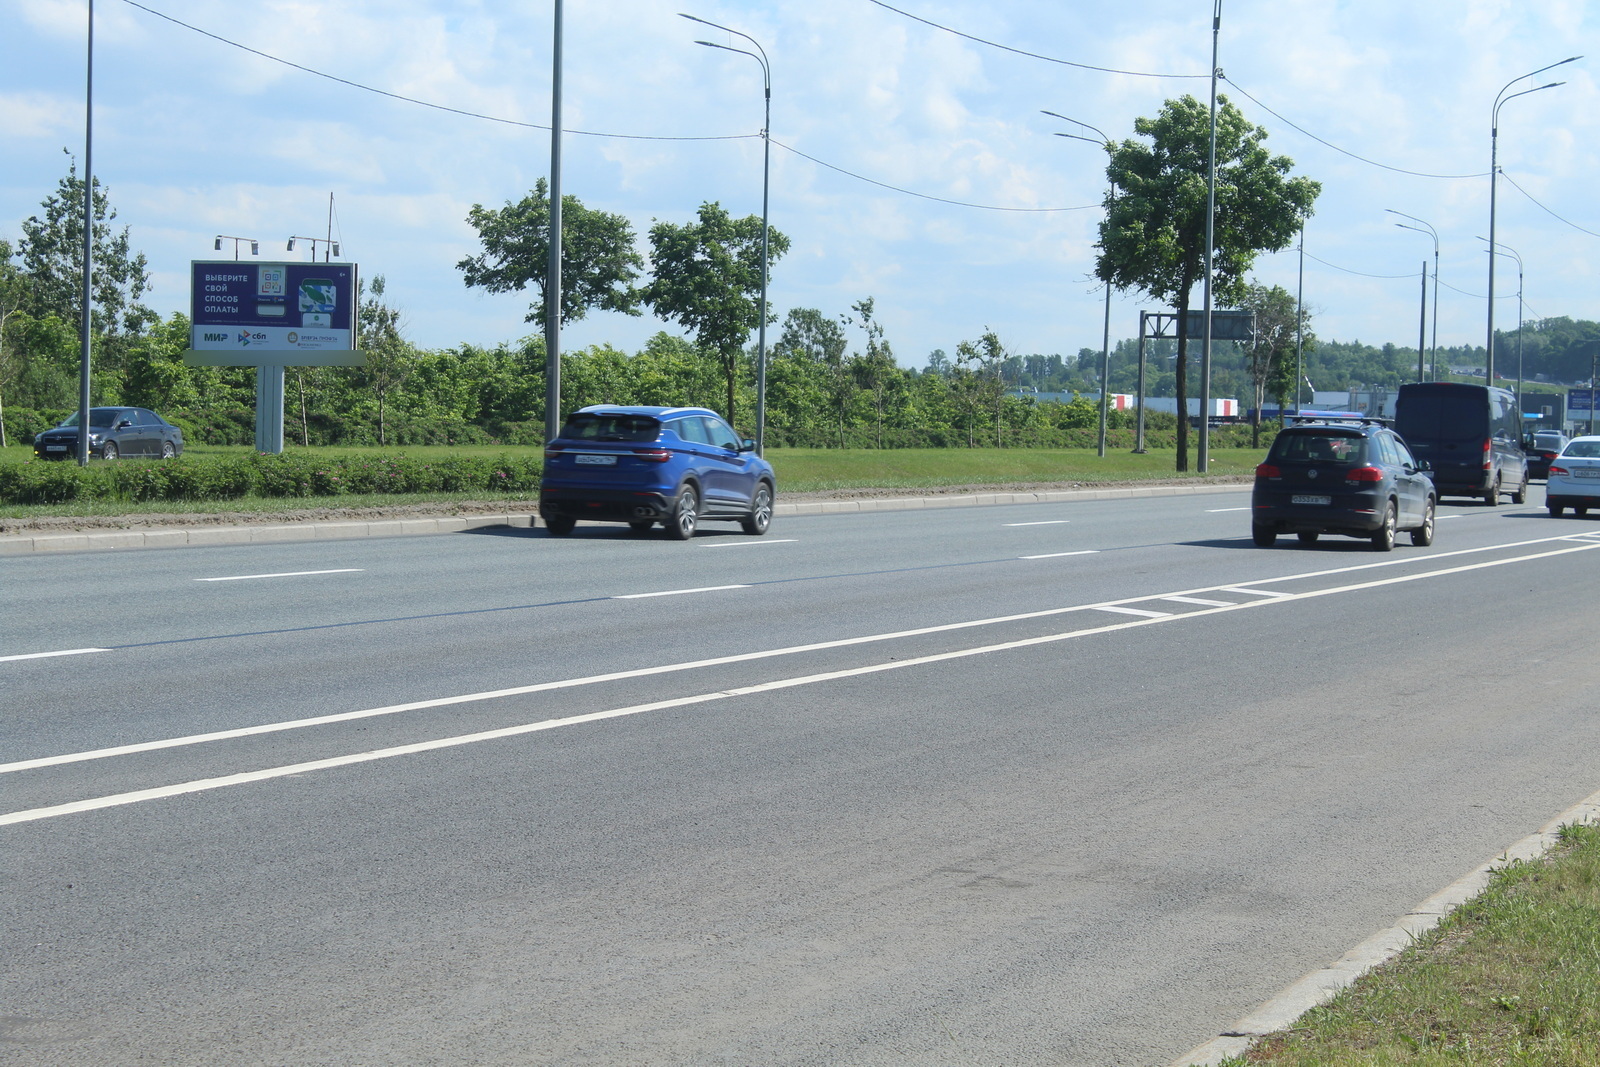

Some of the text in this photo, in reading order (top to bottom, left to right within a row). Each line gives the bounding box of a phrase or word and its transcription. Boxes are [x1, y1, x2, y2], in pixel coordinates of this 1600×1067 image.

[205, 274, 248, 282] ВЫБЕРИТЕ
[204, 283, 228, 292] СВОЙ
[204, 305, 239, 313] ОПЛАТЫ
[204, 333, 229, 342] МИР
[251, 332, 267, 340] сбп
